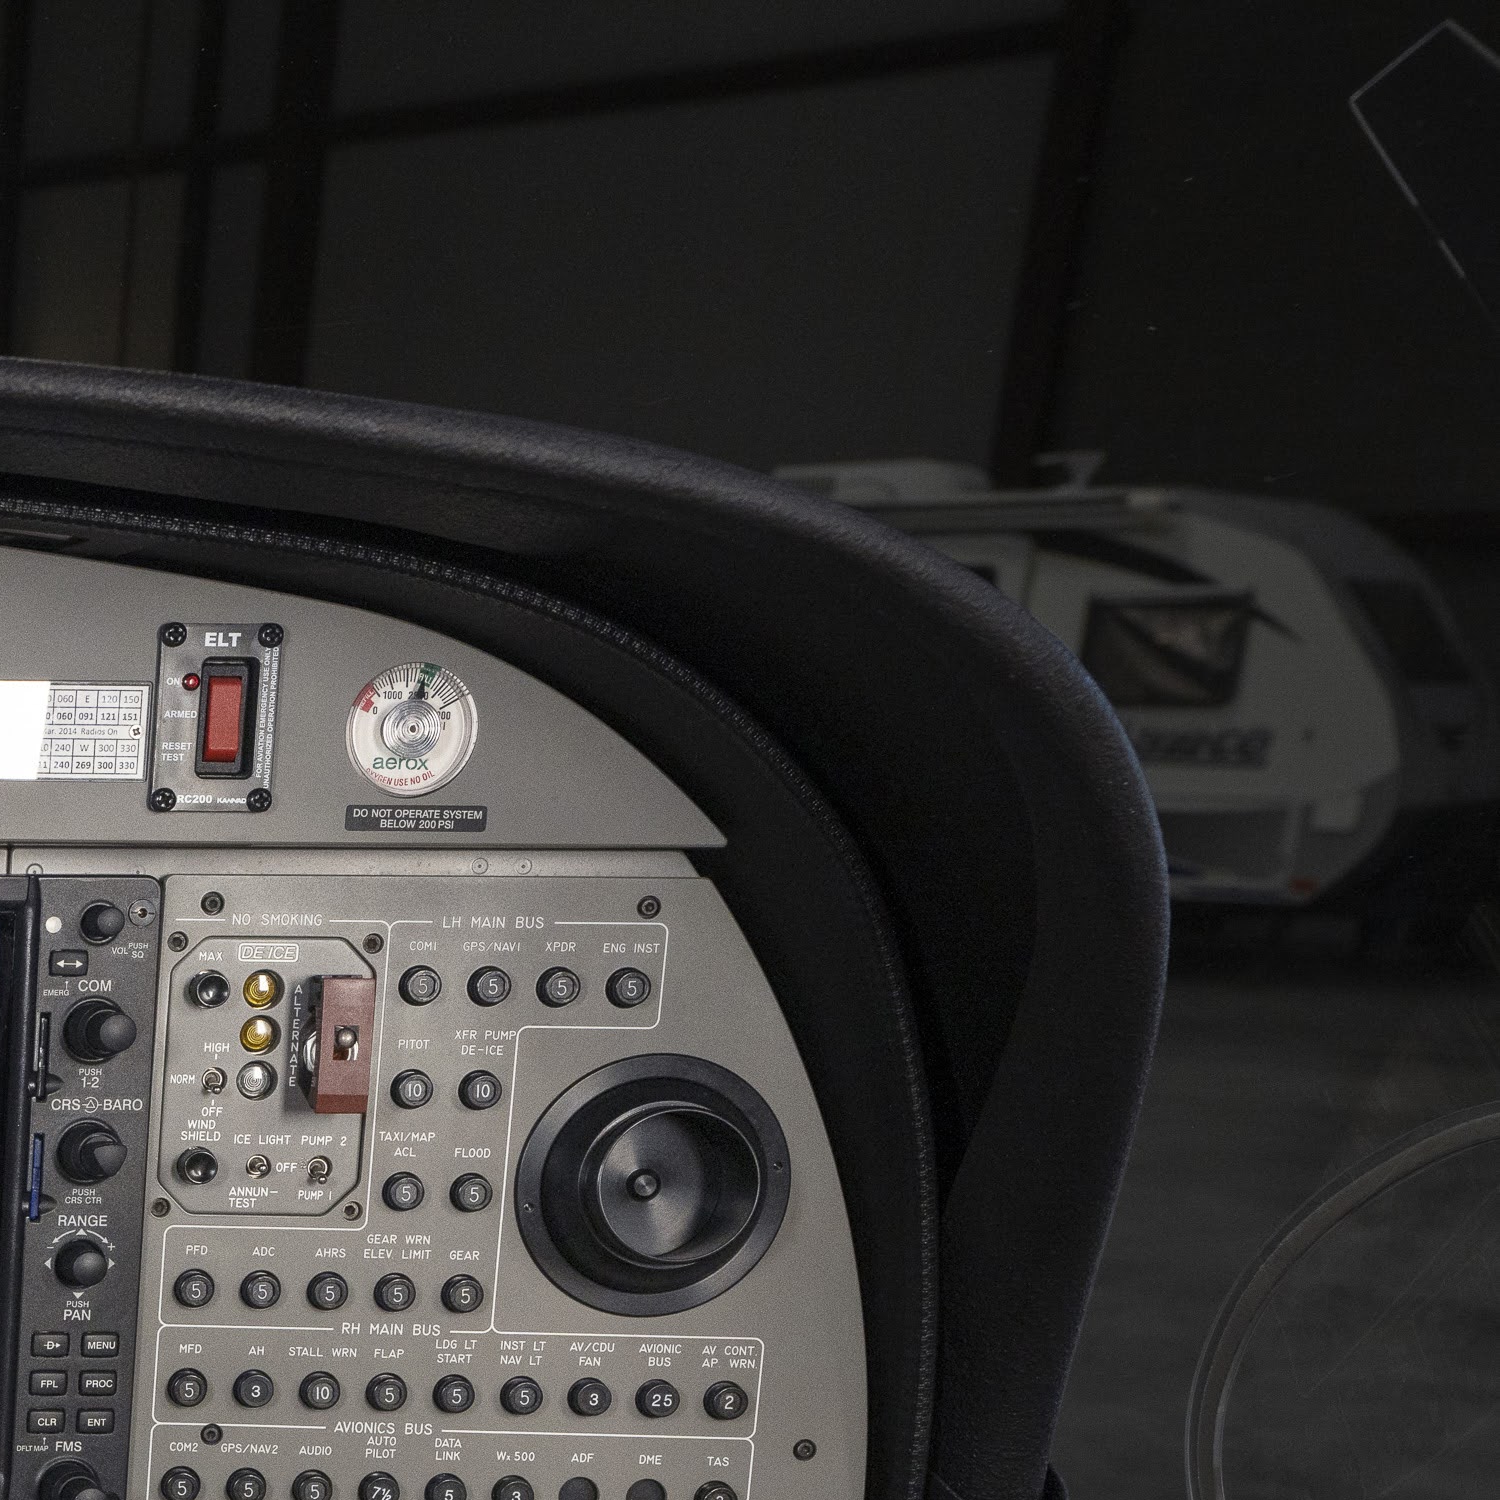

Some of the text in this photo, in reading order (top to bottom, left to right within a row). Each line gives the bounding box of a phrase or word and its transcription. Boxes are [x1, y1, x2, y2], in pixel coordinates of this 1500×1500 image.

[205, 633, 241, 647] ELT
[164, 710, 197, 718] ARMED
[59, 727, 118, 736] 2014 Radios On
[162, 742, 192, 750] RESET
[54, 761, 134, 770] 240 269 300 330
[373, 756, 428, 771] aerox
[176, 795, 212, 803] RC200
[353, 809, 482, 819] DO NOT OPERATE SYSTEM
[380, 819, 454, 829] BELOW 200 PSI
[232, 914, 322, 925] NO SMOKING
[443, 916, 544, 928] LH MAIN BUS
[170, 1074, 195, 1083] NORM
[181, 1131, 221, 1141] SHIELD
[315, 1248, 346, 1258] AHRS
[288, 1347, 357, 1357] STALL WRN
[374, 1349, 404, 1359] FLAP
[639, 1344, 681, 1354] AVIONIC
[221, 1443, 278, 1454] GPS/NAV2
[707, 1456, 729, 1466] TAS
